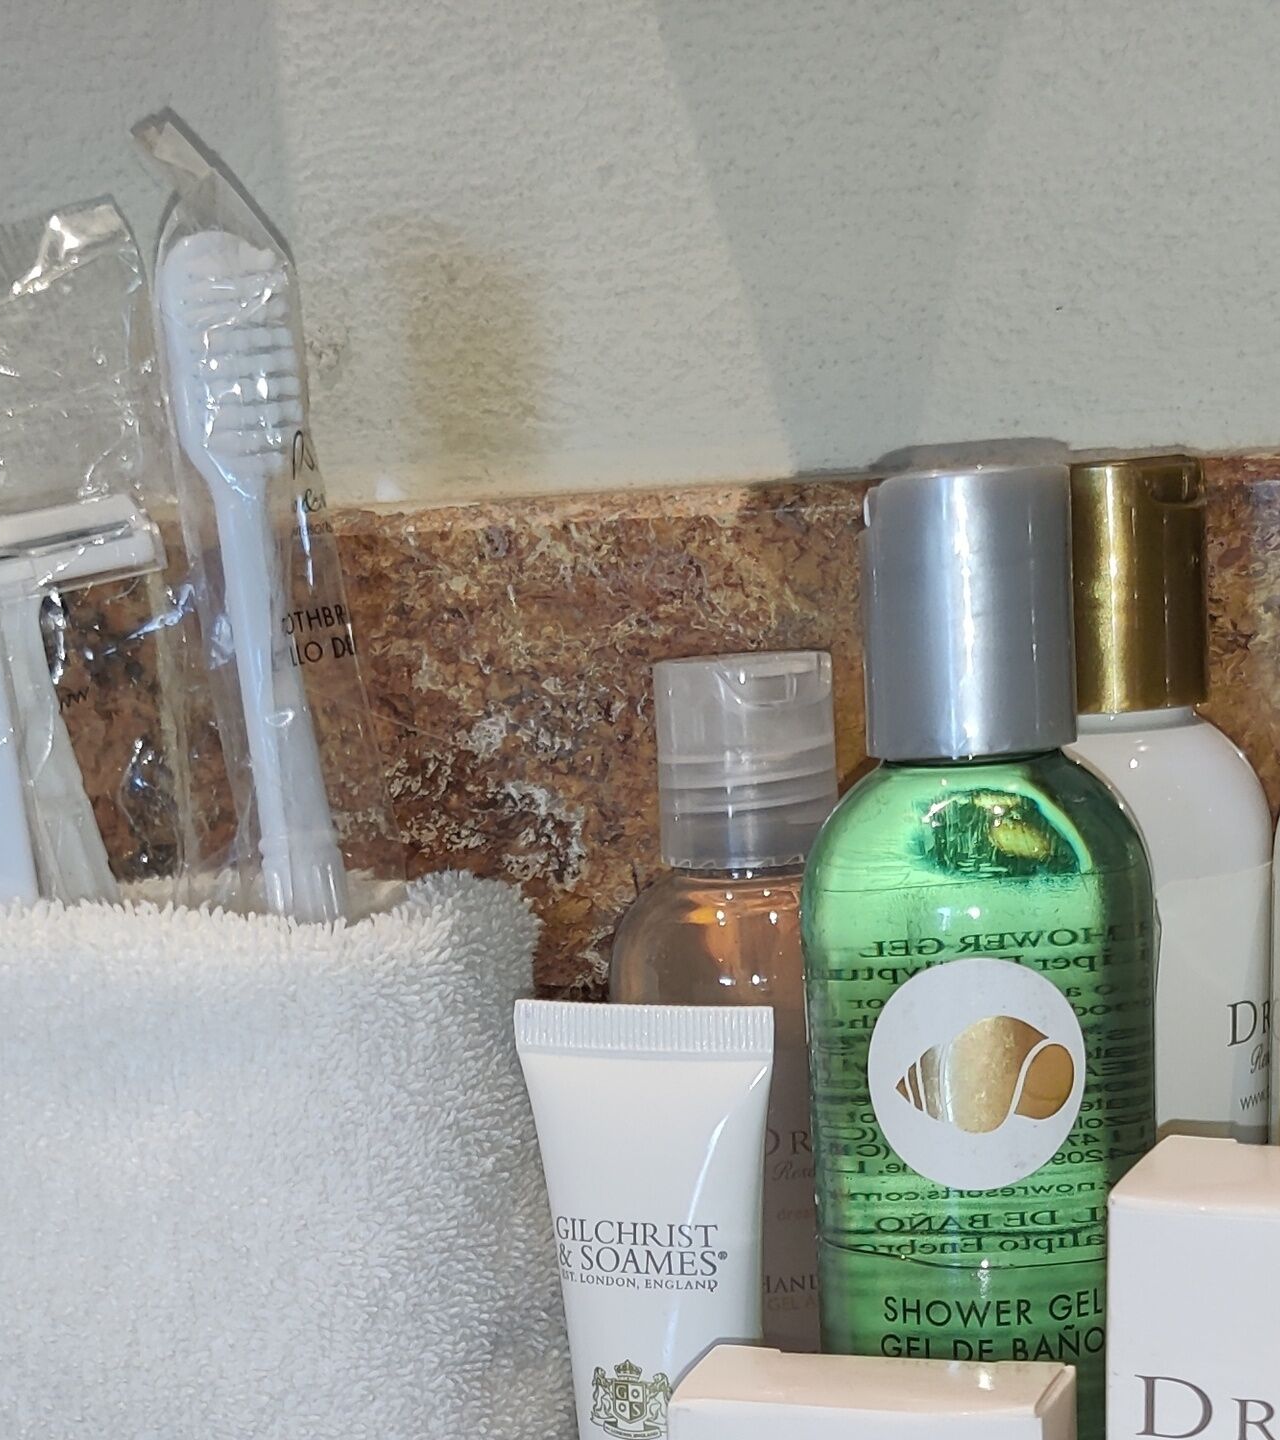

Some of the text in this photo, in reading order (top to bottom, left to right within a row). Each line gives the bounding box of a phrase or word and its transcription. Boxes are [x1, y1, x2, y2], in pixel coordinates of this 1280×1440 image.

[555, 1215, 719, 1248] GILCHRIST
[559, 1242, 572, 1268] &
[580, 1275, 640, 1290] LONDON,
[644, 1279, 719, 1292] ENGLAND
[883, 1287, 1104, 1328] SHOWER GEL
[1012, 1323, 1106, 1362] BAÑO
